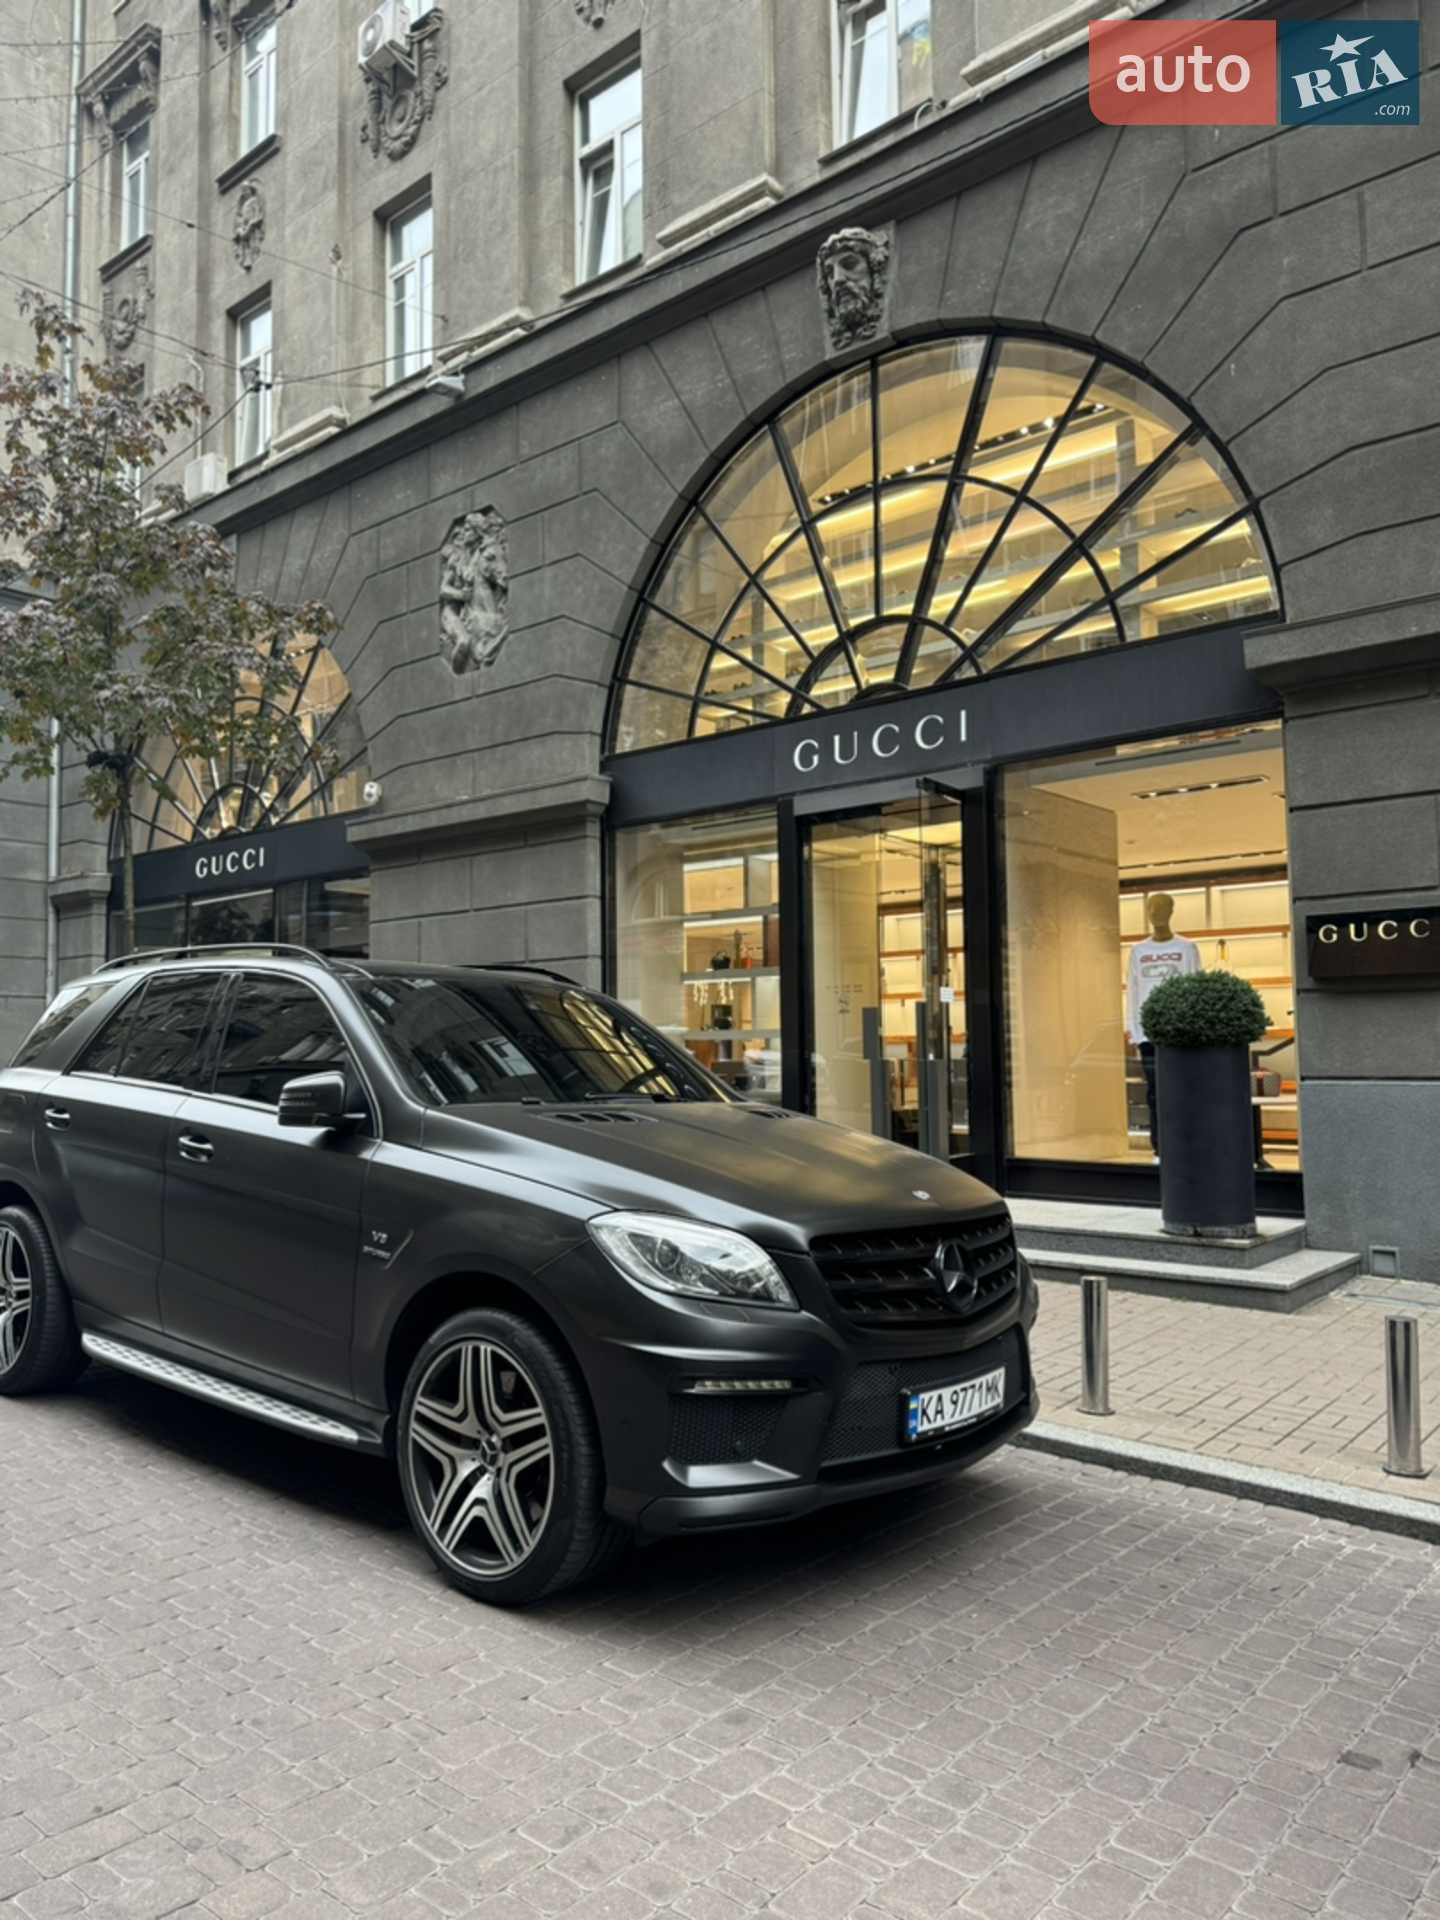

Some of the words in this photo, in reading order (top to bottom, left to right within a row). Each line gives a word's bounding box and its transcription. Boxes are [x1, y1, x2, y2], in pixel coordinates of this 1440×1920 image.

[793, 709, 967, 772] GUCCI
[195, 847, 265, 878] GUCCI
[920, 1393, 945, 1427] KA
